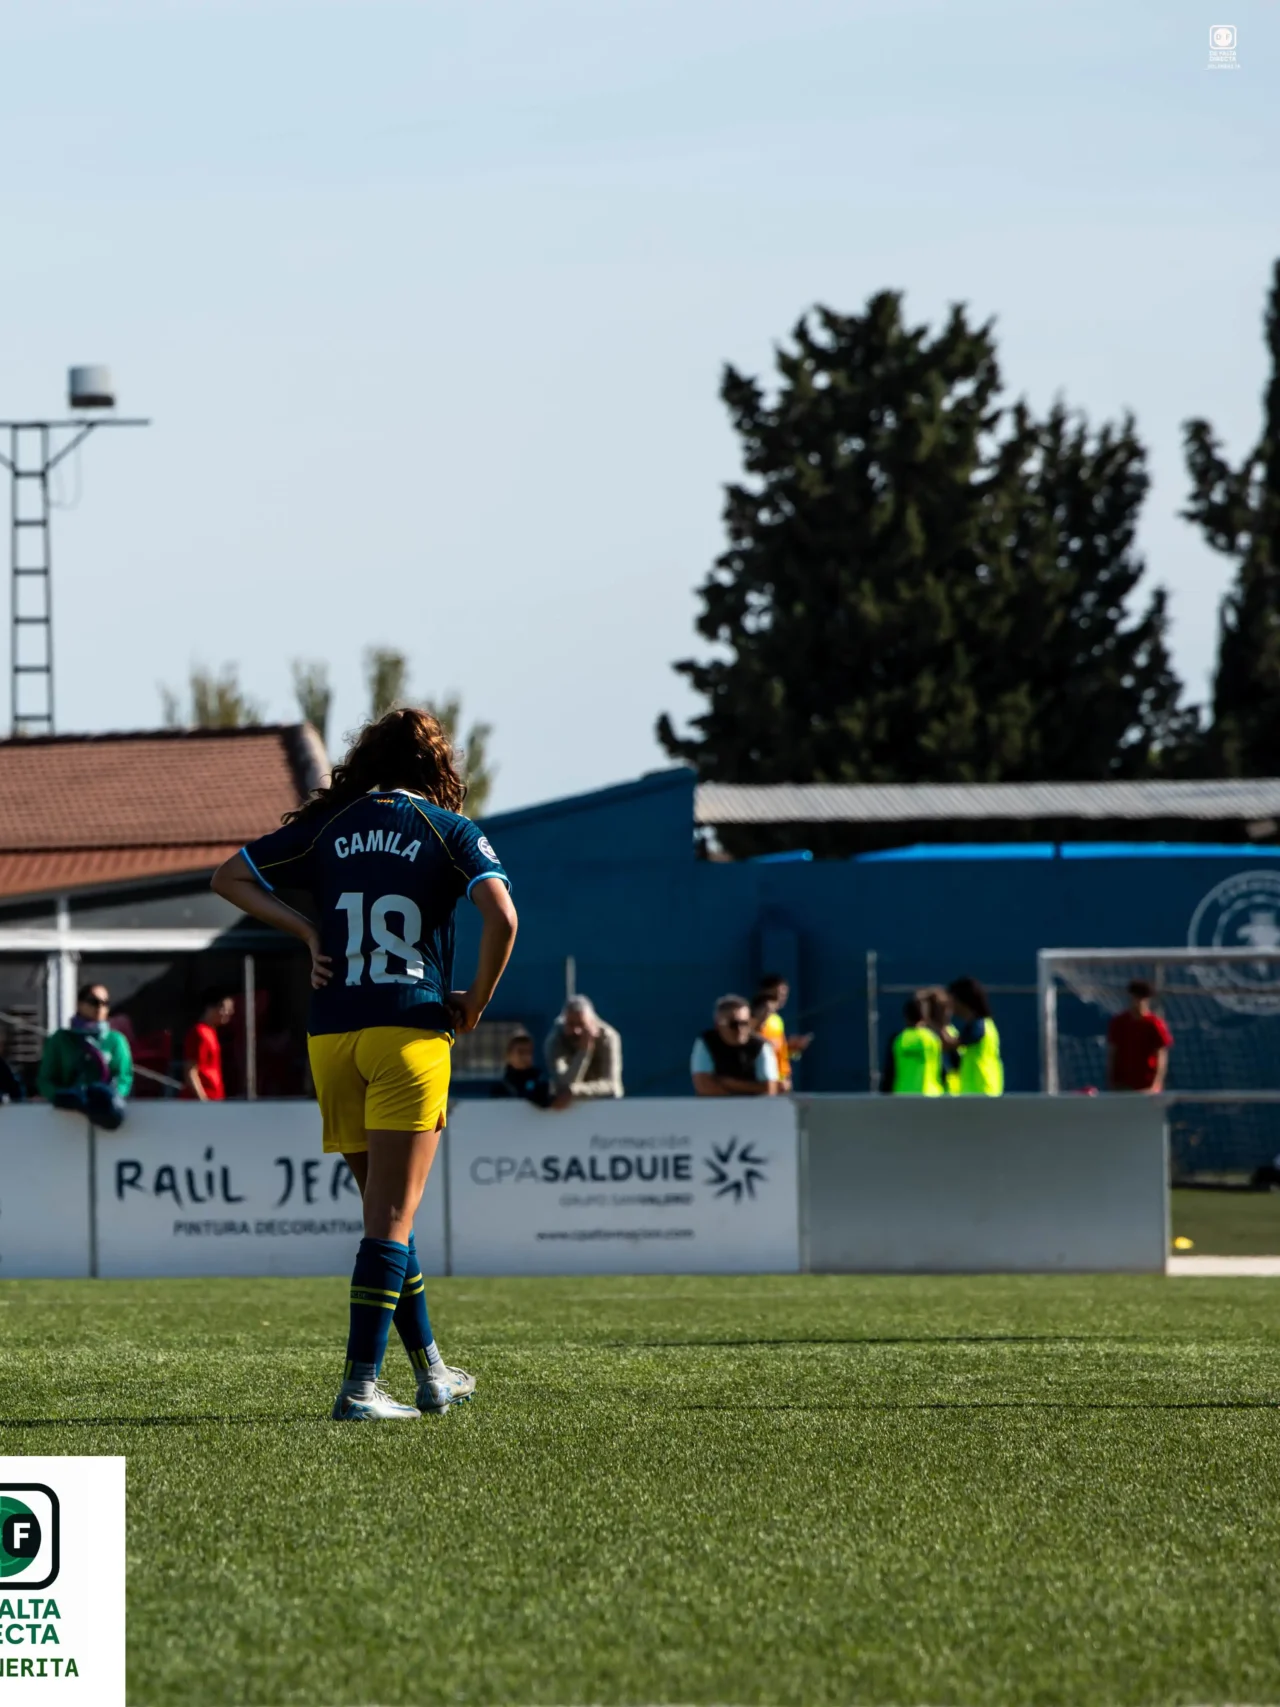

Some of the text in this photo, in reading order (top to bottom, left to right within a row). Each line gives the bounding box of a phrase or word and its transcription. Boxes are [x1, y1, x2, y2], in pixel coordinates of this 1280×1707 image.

[334, 829, 422, 862] CAMILA
[334, 891, 425, 987] 18
[469, 1155, 693, 1185] CPASALDUIE
[173, 1219, 251, 1236] PINTURA
